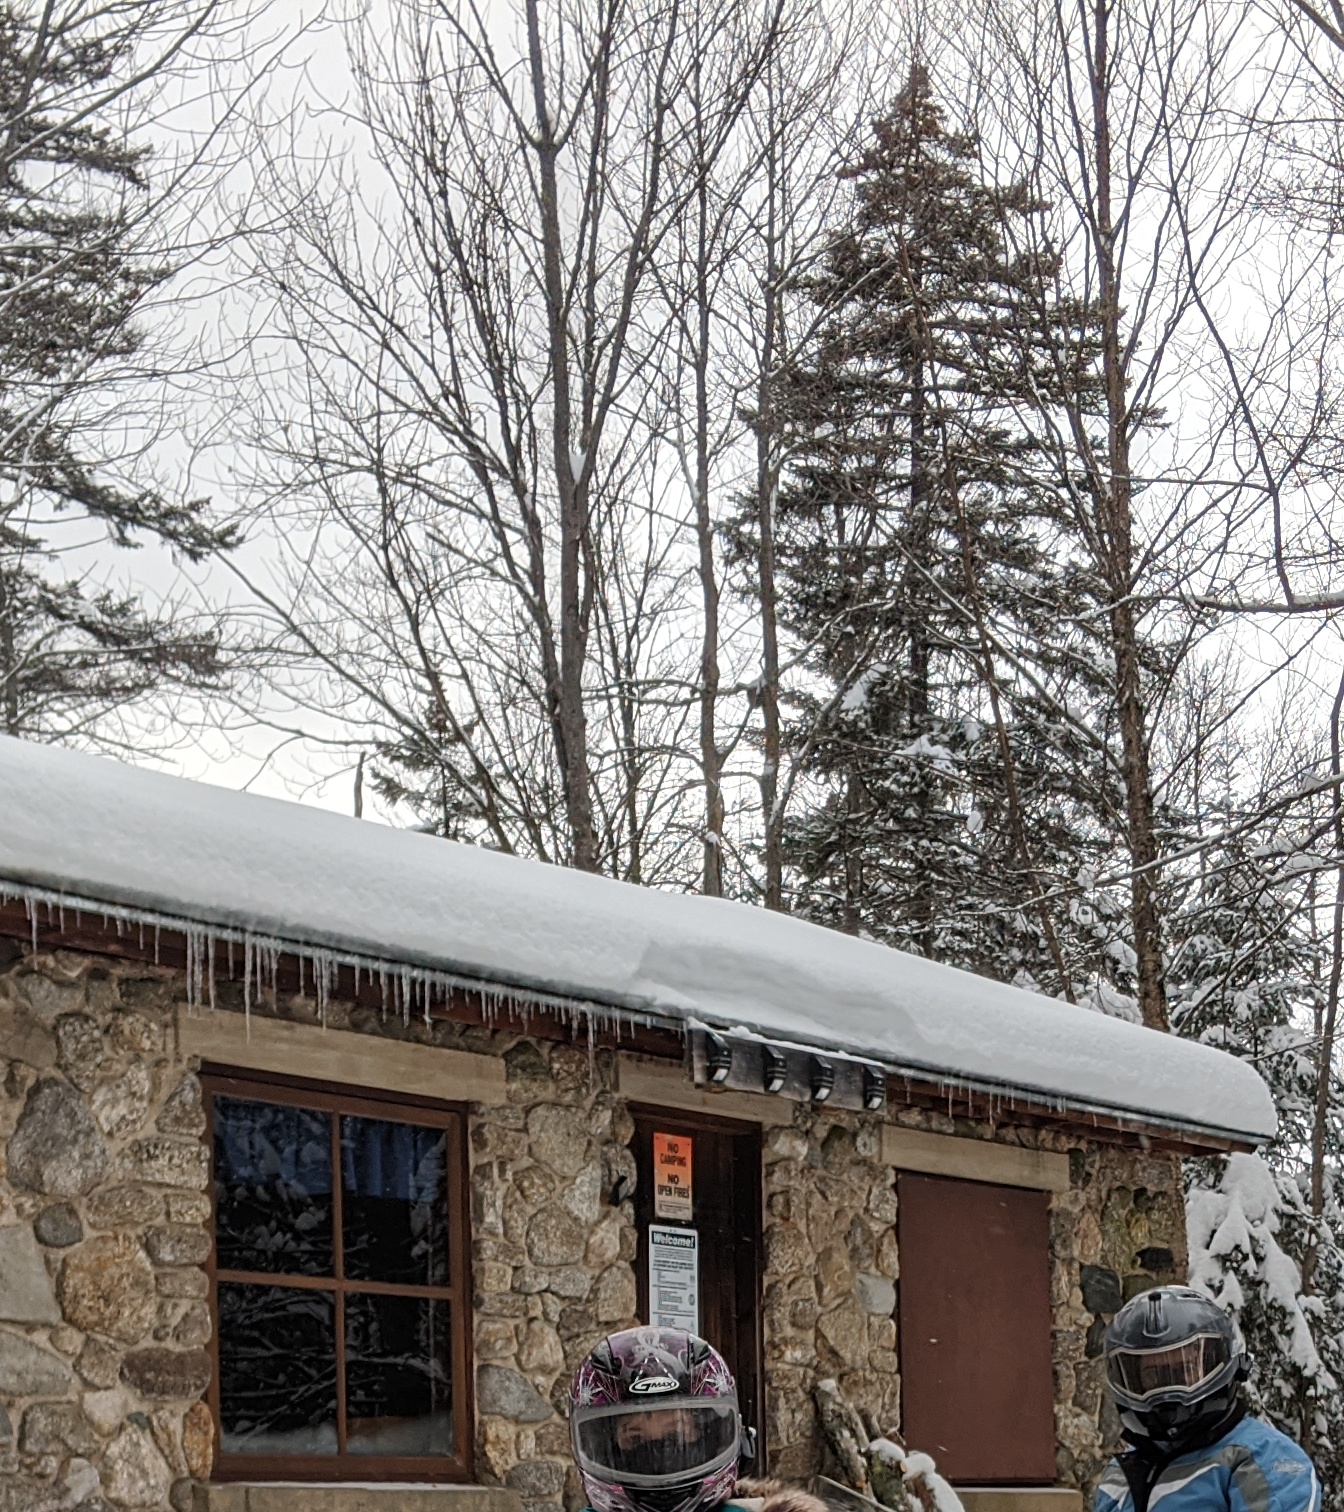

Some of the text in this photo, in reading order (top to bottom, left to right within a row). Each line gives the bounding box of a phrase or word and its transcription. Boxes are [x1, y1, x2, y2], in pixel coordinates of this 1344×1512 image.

[668, 1143, 679, 1153] NO
[660, 1153, 687, 1167] CAMPING
[668, 1173, 679, 1185] NO
[658, 1184, 673, 1197] OPEN
[653, 1232, 695, 1248] Welcome!
